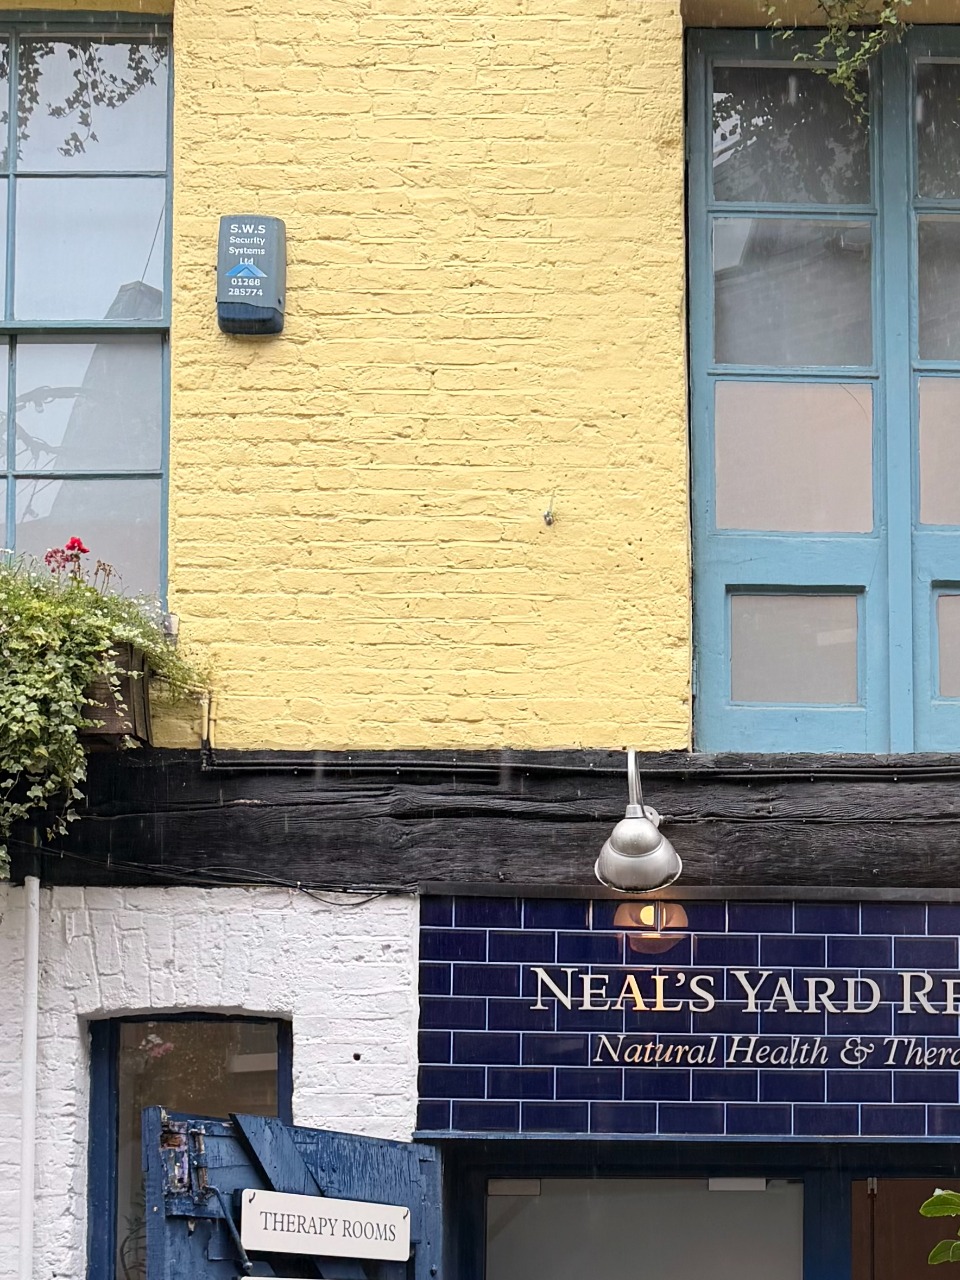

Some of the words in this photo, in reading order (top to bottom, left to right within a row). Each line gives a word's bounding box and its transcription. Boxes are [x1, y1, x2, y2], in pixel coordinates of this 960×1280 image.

[230, 224, 266, 234] S.W.S
[229, 235, 265, 245] Security
[228, 246, 266, 255] Systems
[239, 257, 254, 265] Ltd
[529, 967, 716, 1013] NEAL'S
[729, 970, 881, 1014] YARD
[593, 1034, 718, 1065] Natural
[723, 1036, 829, 1066] Health
[840, 1040, 875, 1066] &
[260, 1211, 338, 1237] THERAPY
[342, 1219, 396, 1242] ROOMS
